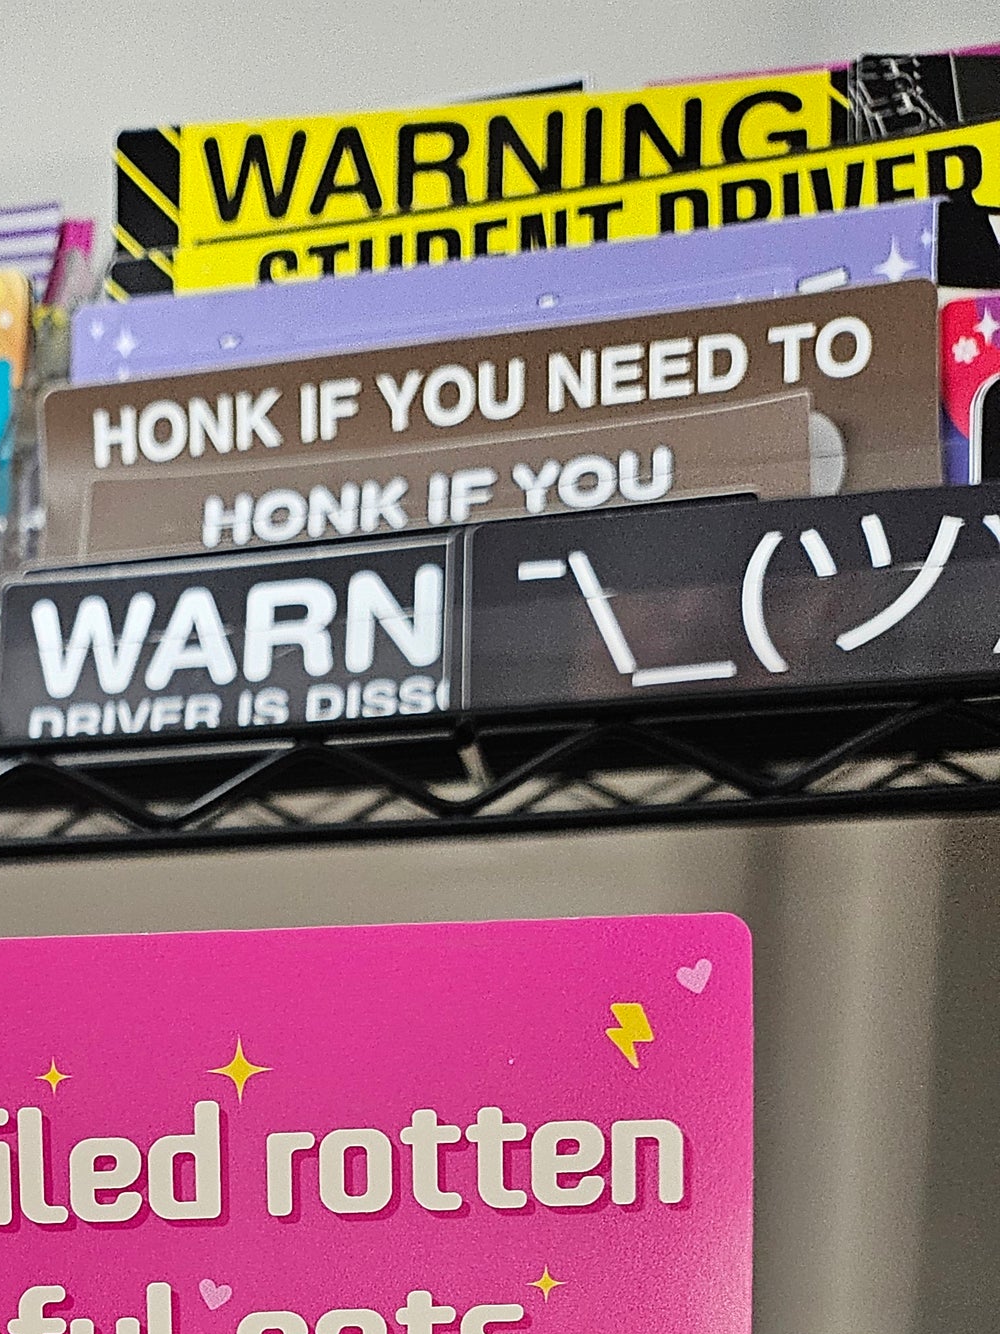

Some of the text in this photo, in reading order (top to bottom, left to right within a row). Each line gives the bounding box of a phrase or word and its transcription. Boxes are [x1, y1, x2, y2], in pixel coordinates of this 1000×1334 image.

[203, 91, 808, 222] WARNING
[93, 316, 872, 468] HONK IF YOU NEED TO
[202, 445, 674, 548] HONK IF YOU
[31, 563, 445, 698] WARN
[29, 692, 223, 739] DRIVER
[238, 686, 290, 727] IS
[265, 1106, 686, 1217] rotten
